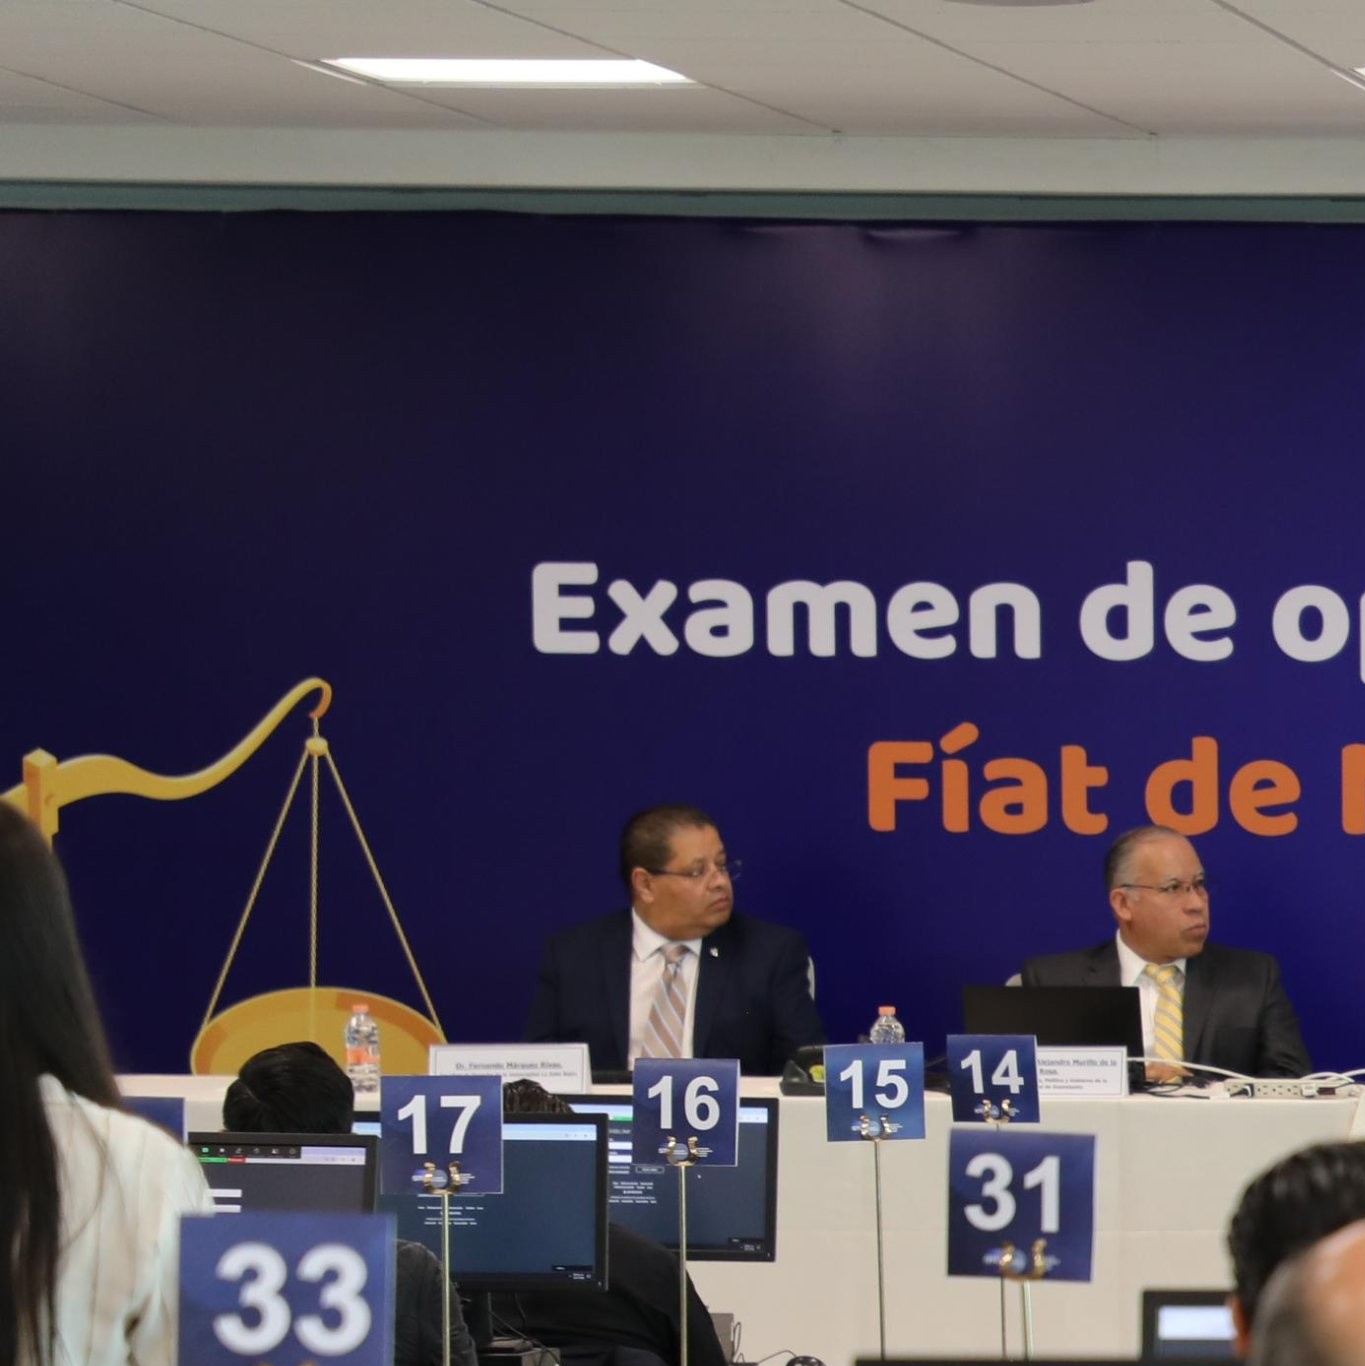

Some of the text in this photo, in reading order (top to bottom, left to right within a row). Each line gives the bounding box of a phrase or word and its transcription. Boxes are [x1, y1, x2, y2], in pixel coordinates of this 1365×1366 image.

[531, 562, 1042, 660] Examen
[1078, 560, 1238, 662] de
[867, 722, 1109, 835] Fíat
[1144, 736, 1301, 836] de
[648, 1075, 720, 1131] 16
[839, 1059, 909, 1109] 15
[960, 1049, 1025, 1094] 14
[397, 1094, 482, 1155] 17
[963, 1152, 1061, 1233] 31
[213, 1242, 372, 1356] 33
